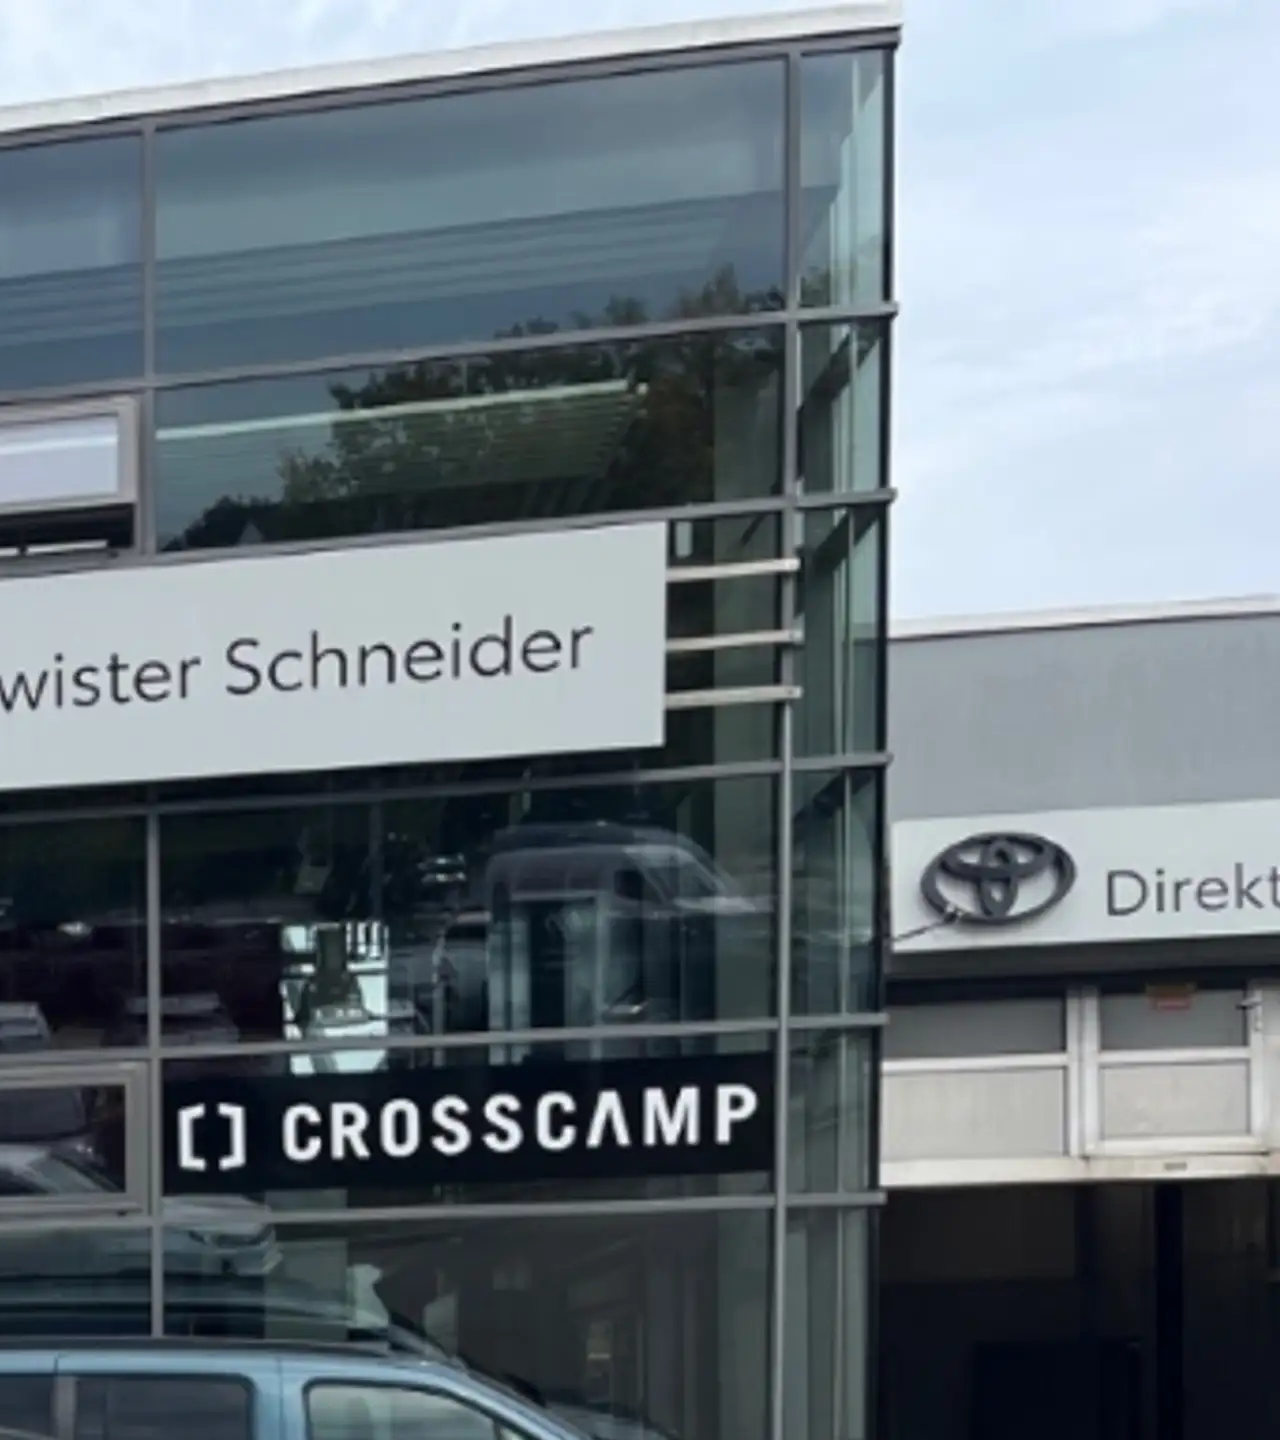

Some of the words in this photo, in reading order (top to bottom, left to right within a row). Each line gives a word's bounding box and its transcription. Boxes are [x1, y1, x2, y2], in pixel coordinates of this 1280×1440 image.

[226, 614, 595, 698] Schneider
[1107, 862, 1280, 918] Direkt
[282, 1085, 759, 1163] CROSSCAMP
